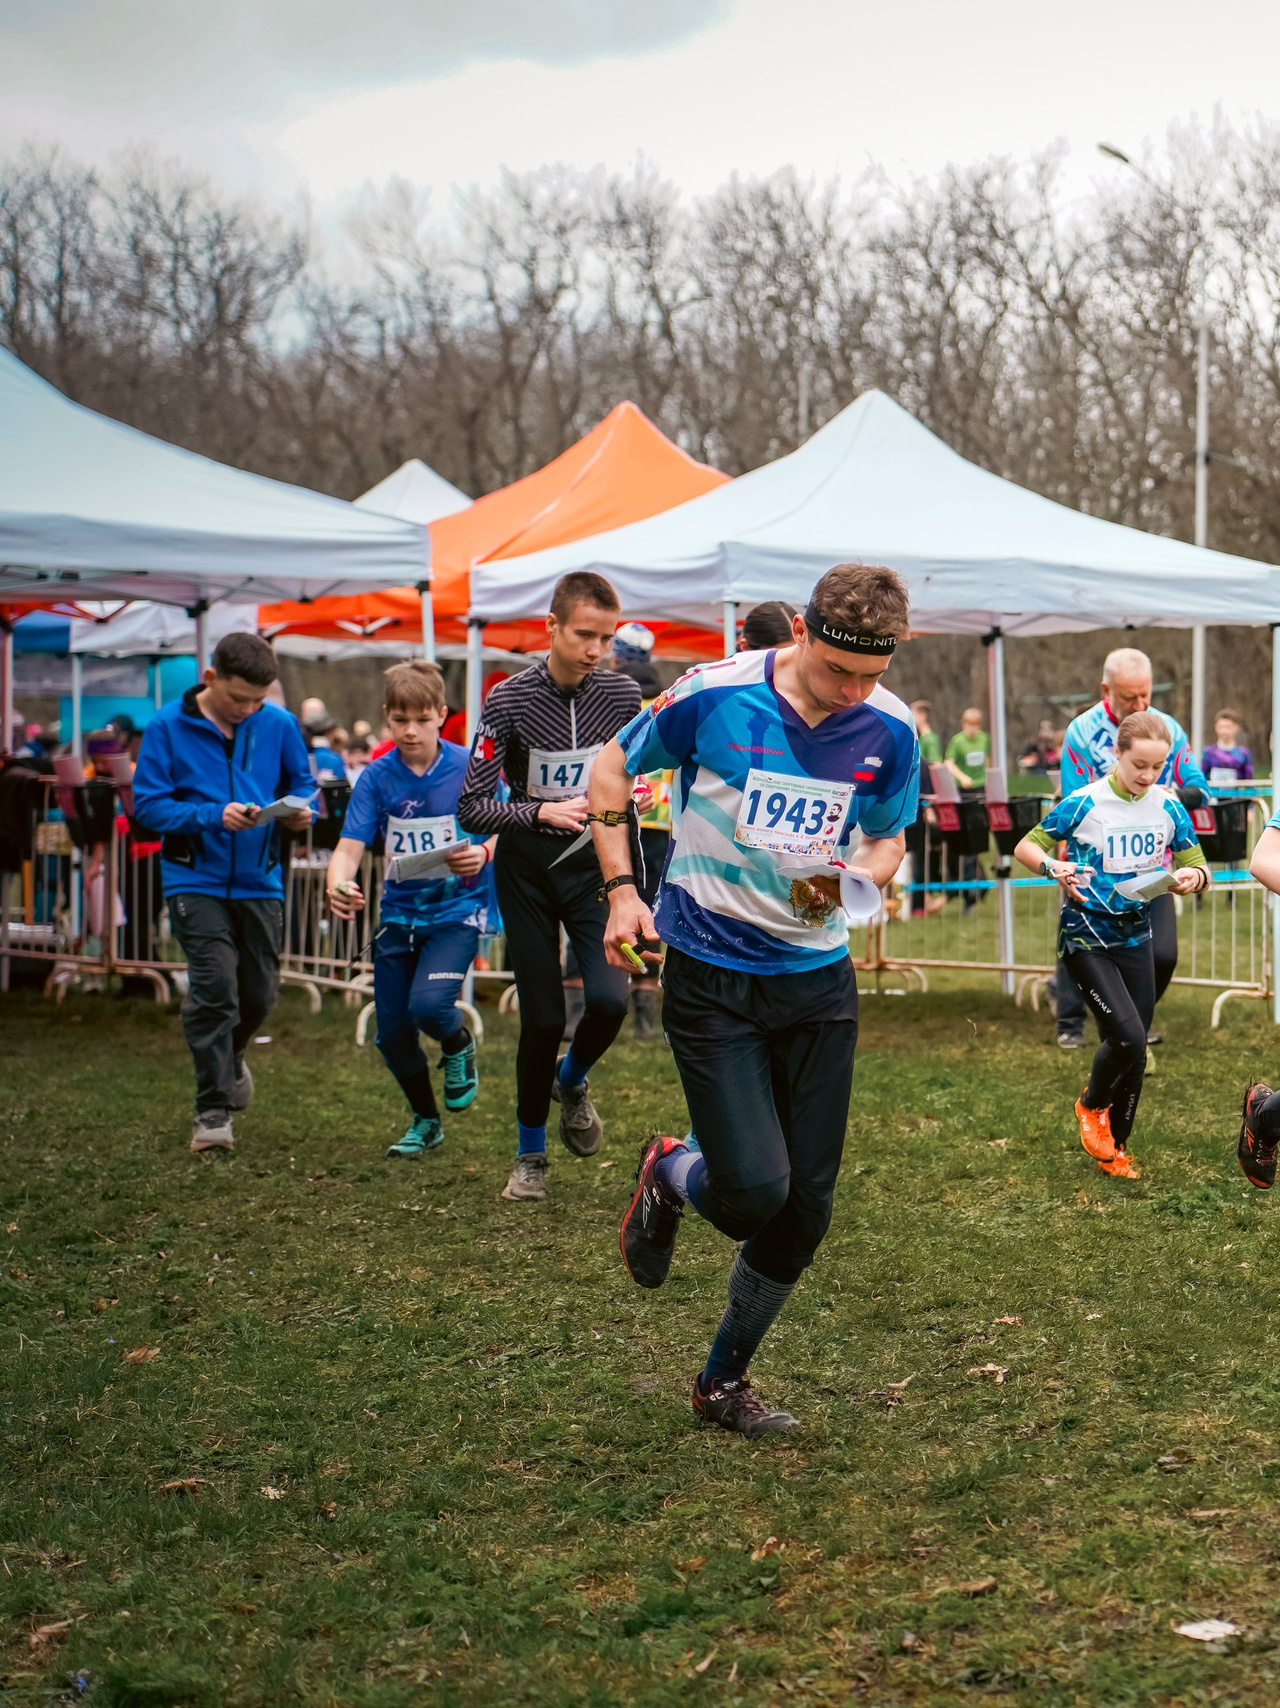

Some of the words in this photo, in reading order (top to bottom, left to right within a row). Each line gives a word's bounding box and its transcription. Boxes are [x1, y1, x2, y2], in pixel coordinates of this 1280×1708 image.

[540, 763, 584, 787] 147
[746, 789, 827, 836] 1943
[392, 831, 435, 853] 218
[1107, 833, 1155, 858] 1108
